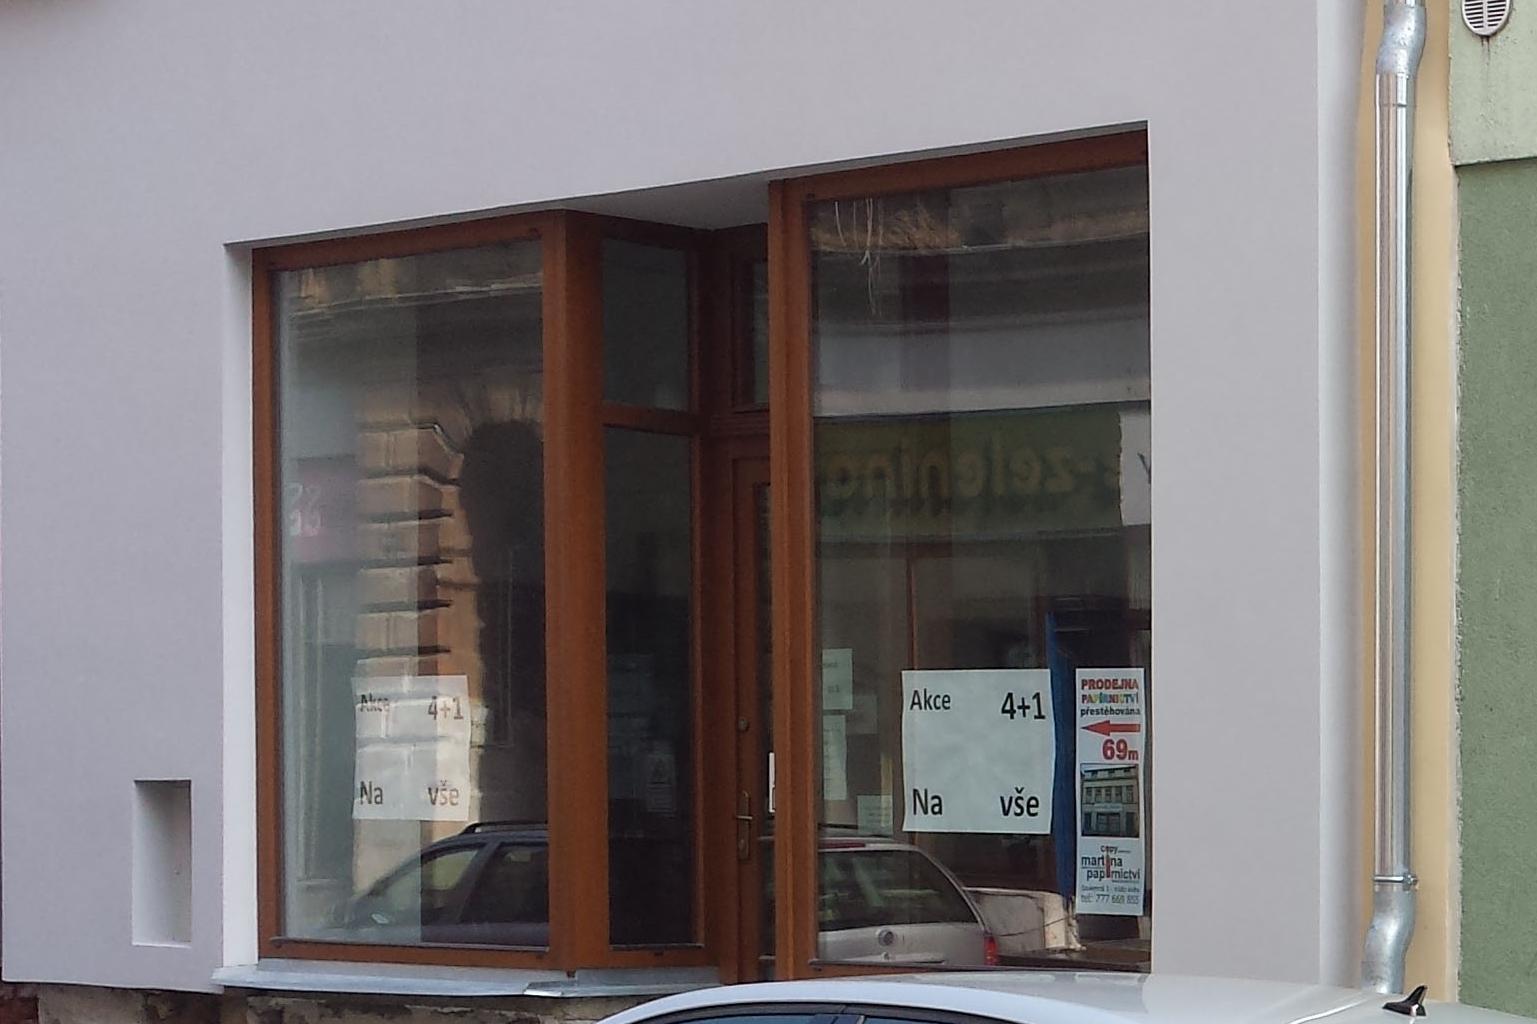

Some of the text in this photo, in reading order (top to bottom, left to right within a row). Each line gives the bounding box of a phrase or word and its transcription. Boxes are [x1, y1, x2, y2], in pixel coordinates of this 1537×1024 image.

[1081, 678, 1139, 690] PRODEJNA
[910, 689, 1045, 720] Akce 4+1
[360, 780, 459, 805] Na vše
[912, 787, 1039, 817] Na vše
